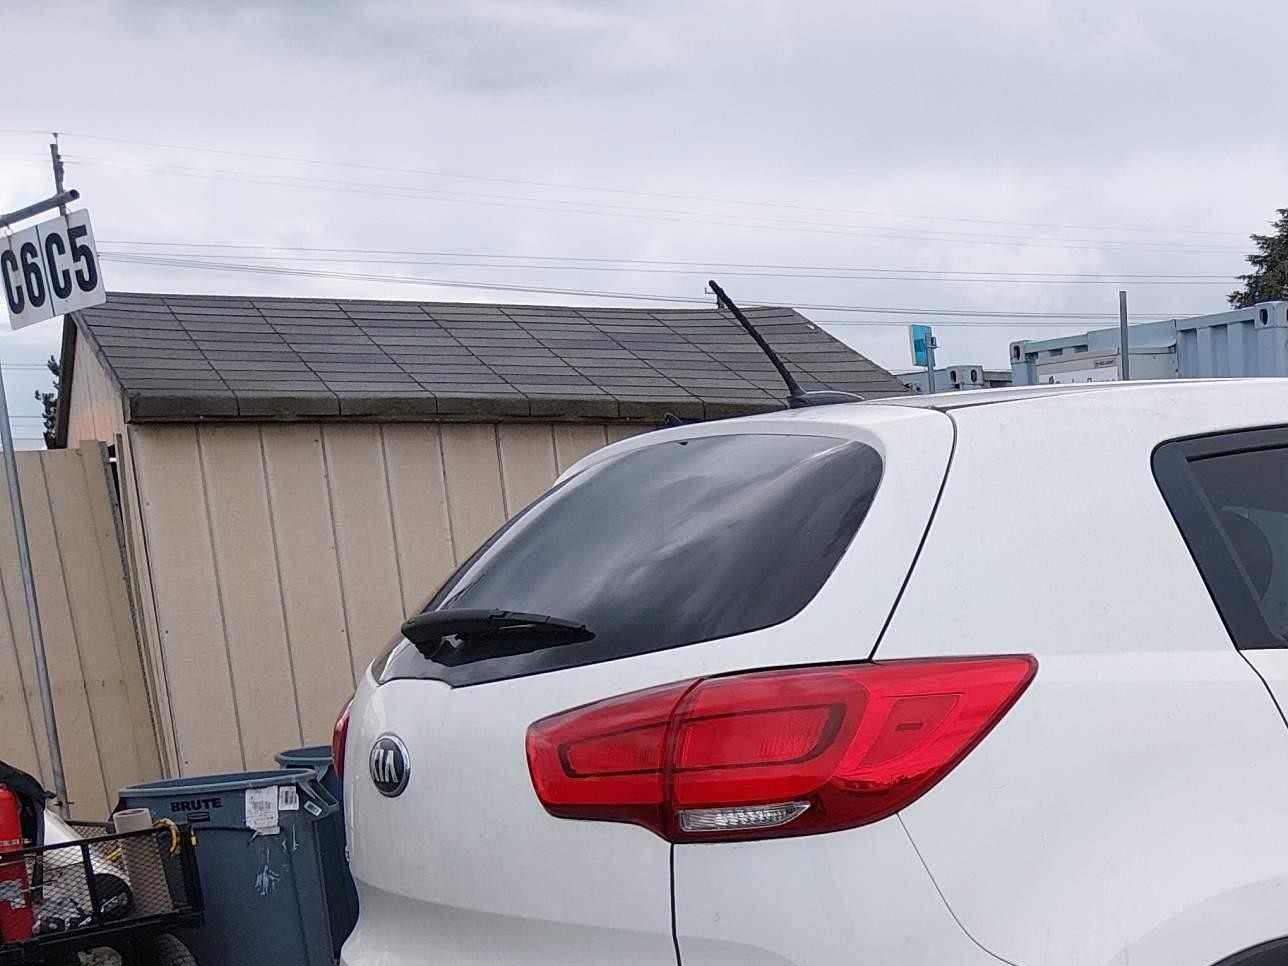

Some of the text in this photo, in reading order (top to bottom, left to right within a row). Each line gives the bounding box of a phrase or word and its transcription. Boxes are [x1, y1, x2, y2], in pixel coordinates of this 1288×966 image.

[1, 224, 98, 315] C6 C5
[372, 749, 399, 783] KIA
[171, 799, 223, 813] BRUTE
